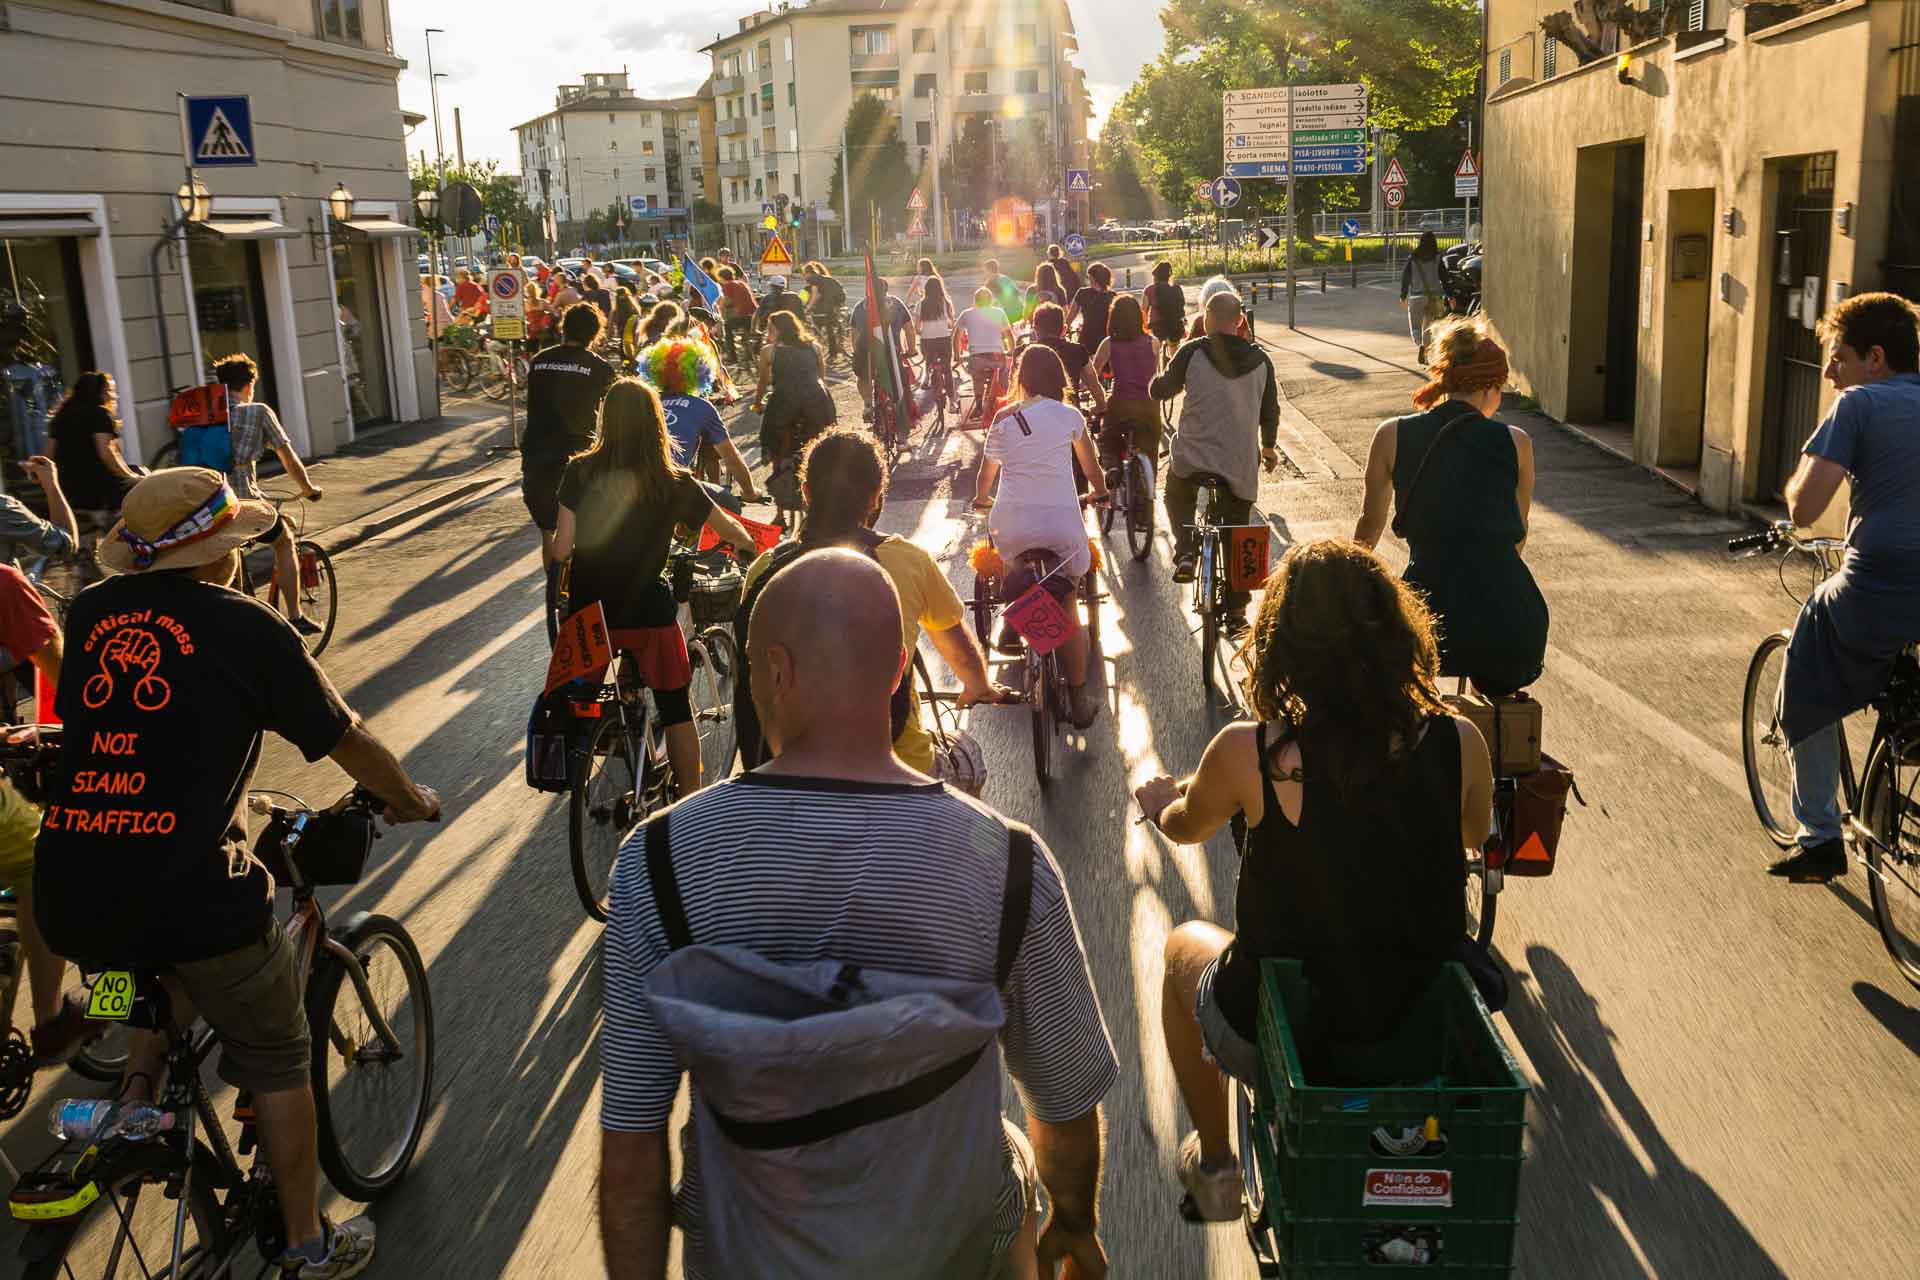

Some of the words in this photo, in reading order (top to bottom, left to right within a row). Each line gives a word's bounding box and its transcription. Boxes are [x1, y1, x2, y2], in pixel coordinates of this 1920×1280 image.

[1240, 91, 1287, 100] SCANDICCI
[1295, 89, 1328, 97] isolotto
[1295, 104, 1322, 113] viadotto
[1261, 164, 1287, 173] SIENA
[1295, 163, 1342, 172] PRATO-PISTOIA
[1200, 187, 1211, 196] 30
[1389, 191, 1400, 202] 30
[84, 609, 152, 652] critical
[155, 615, 195, 655] mass
[91, 731, 139, 755] NOI
[71, 771, 146, 795] SIAMO
[64, 807, 177, 834] TRAFFICO
[102, 975, 128, 993] NO
[1414, 1173, 1431, 1184] do
[1373, 1183, 1442, 1194] Confidenza
